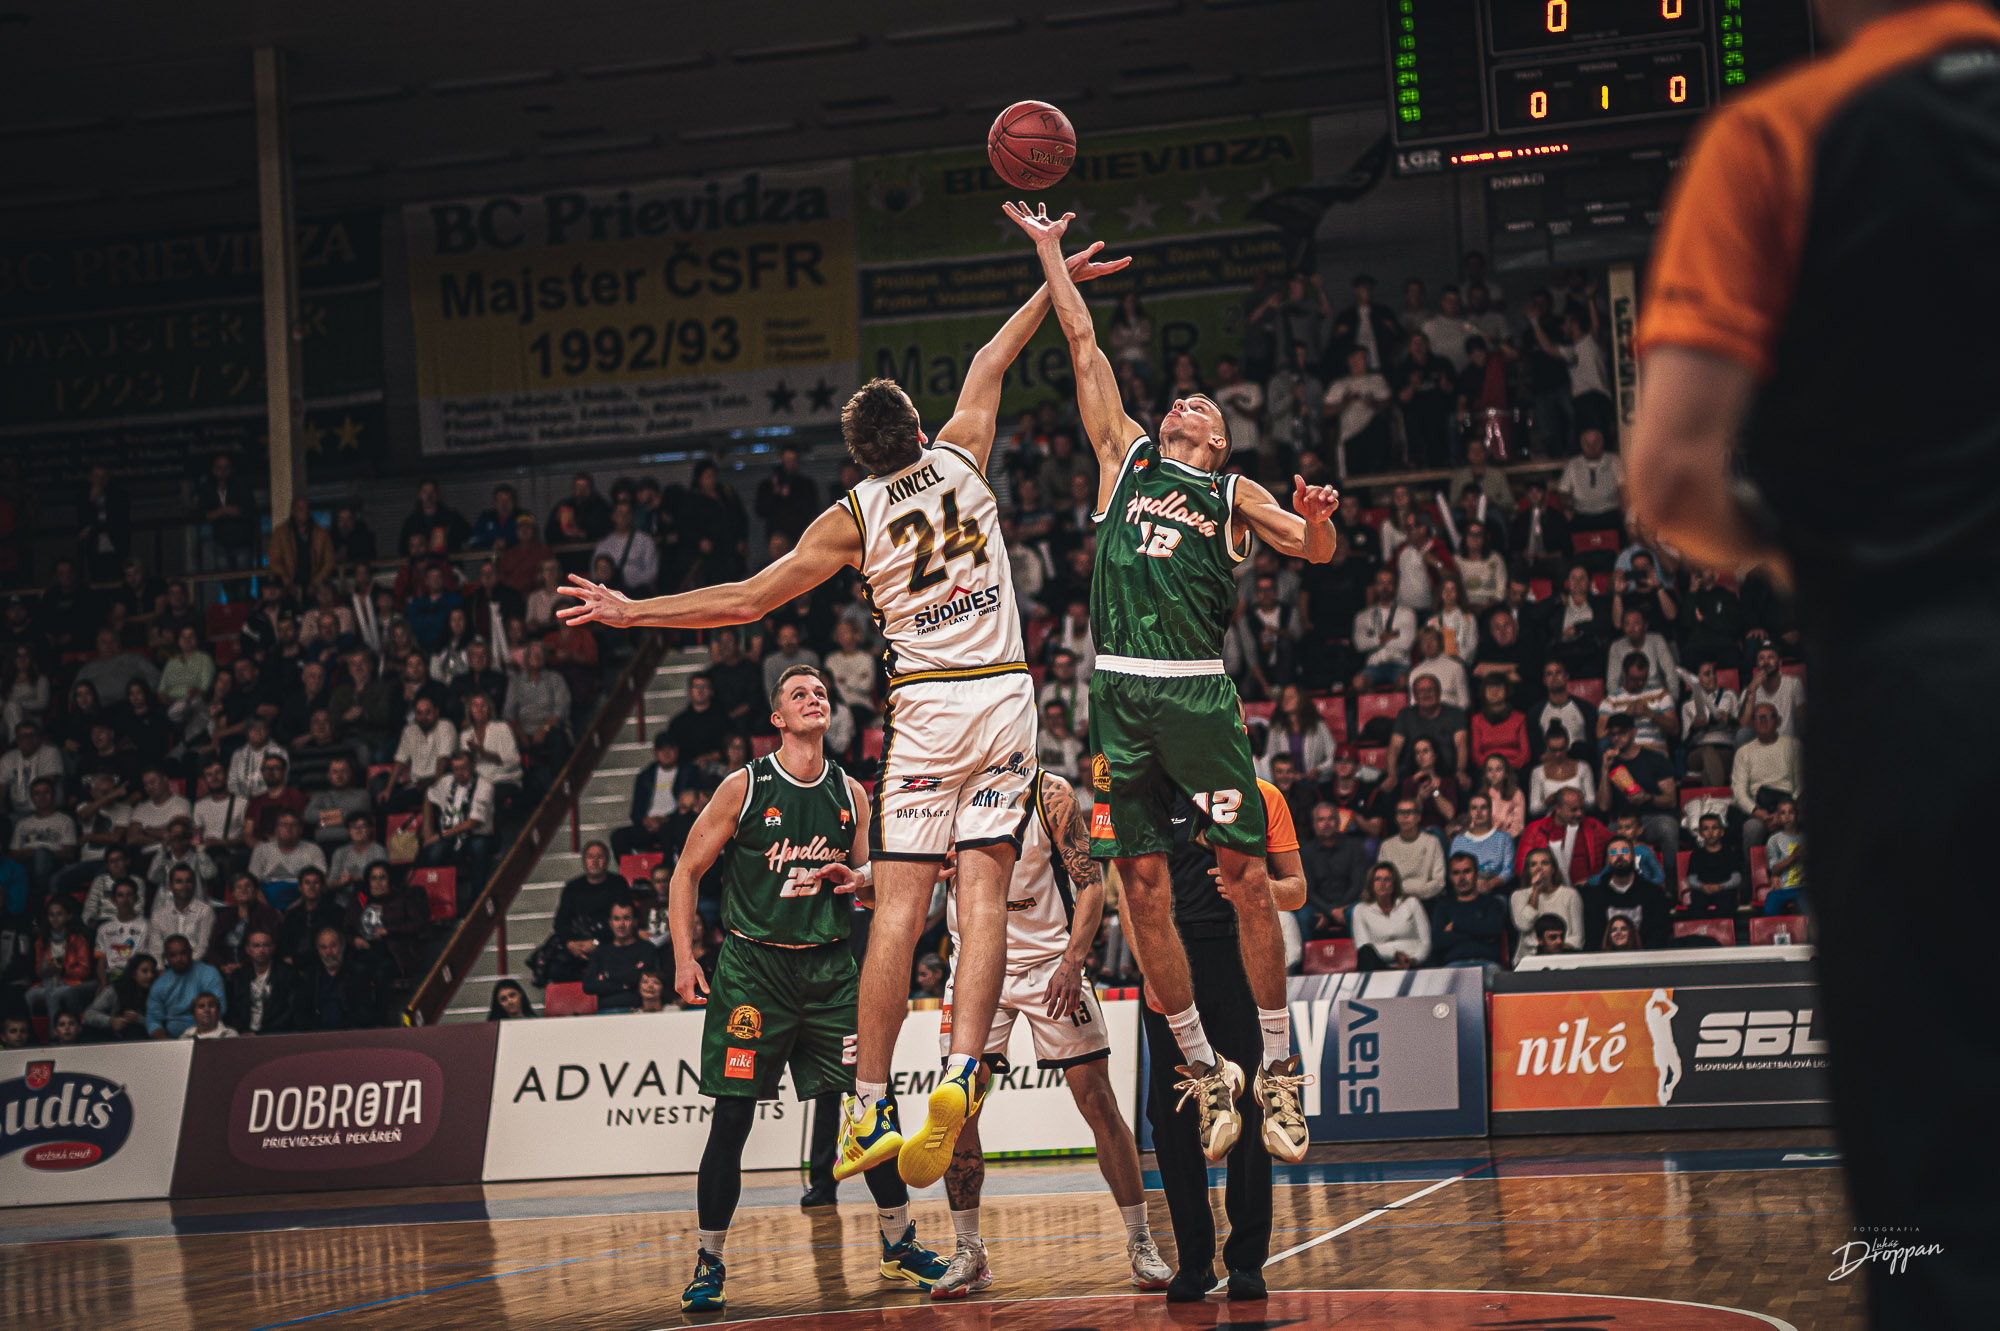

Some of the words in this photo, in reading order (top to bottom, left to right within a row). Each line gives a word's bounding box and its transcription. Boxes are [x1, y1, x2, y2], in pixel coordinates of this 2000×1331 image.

[1547, 0, 1567, 32] 0
[1530, 91, 1547, 118] 0
[1601, 85, 1609, 110] 1
[1670, 76, 1686, 103] 0
[430, 200, 524, 255] BC
[545, 173, 829, 245] Prievidza
[71, 220, 357, 289] PRIEVIZA
[440, 262, 646, 325] Majster
[664, 240, 826, 298] ČSFR
[530, 317, 741, 378] 1992/93
[885, 463, 945, 506] KINCEL
[886, 487, 991, 596] 24
[1135, 520, 1183, 558] 12
[914, 584, 1000, 628] SÜDWEST
[917, 623, 941, 636] FARBY
[949, 614, 971, 626] LAKY
[896, 808, 919, 819] DAPE
[1191, 788, 1243, 824] 12
[779, 866, 822, 898] 25
[1516, 1016, 1627, 1076] niké
[1694, 1009, 1831, 1058] SBL
[1338, 1001, 1380, 1114] stav
[1694, 1061, 1745, 1072] SLOVENSKÁ
[1746, 1059, 1812, 1070] BASKETBALOVÁ
[513, 1059, 786, 1103] ADVAN
[0, 1083, 126, 1136] udiš
[248, 1079, 422, 1133] DOBROTA
[607, 1101, 785, 1127] INVESTMTS
[262, 1131, 341, 1149] PRIEVIDZSKÁ
